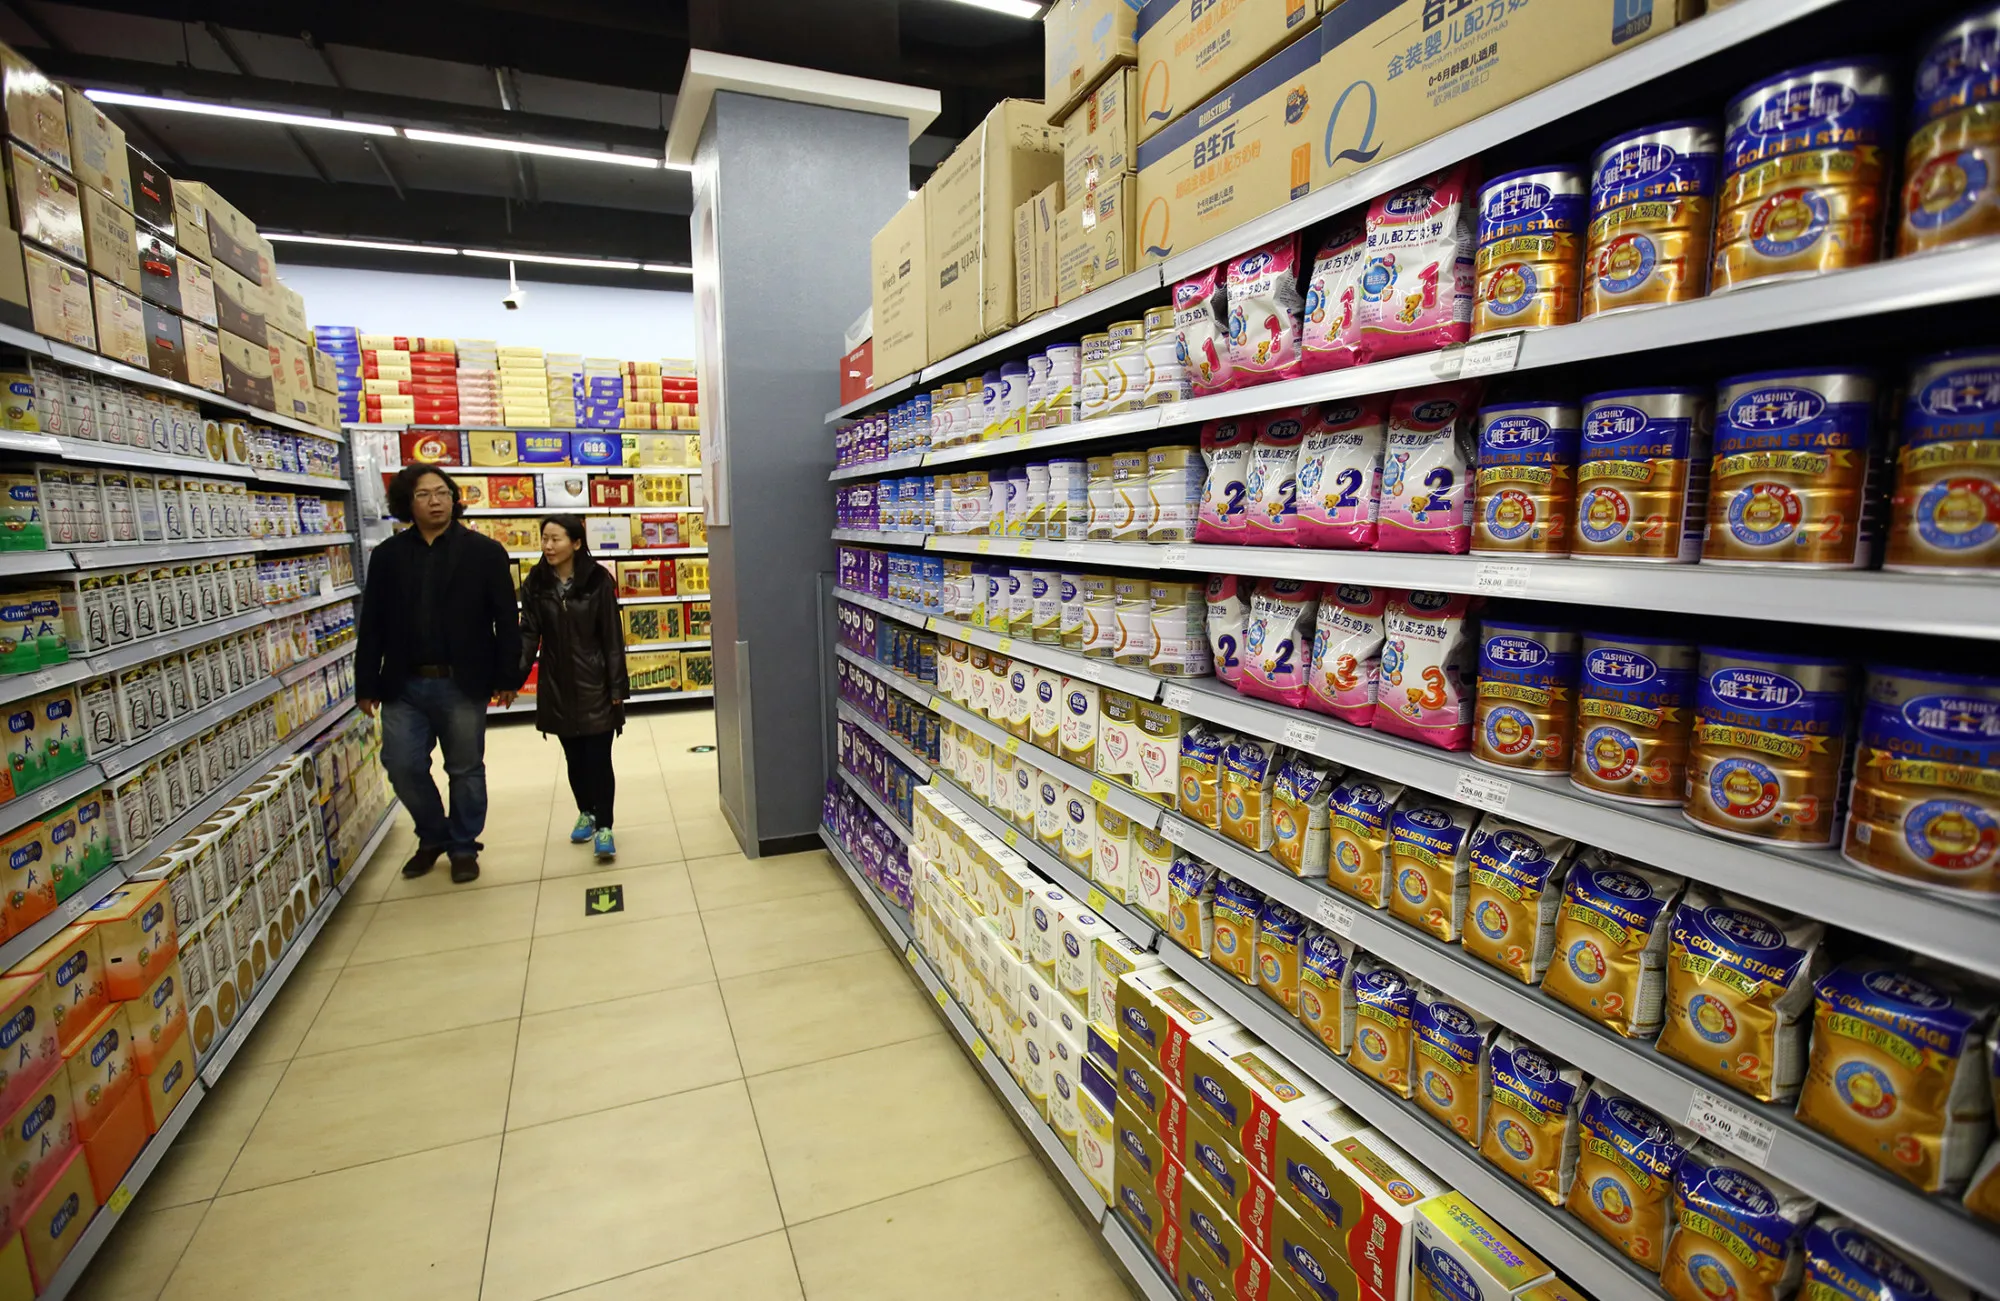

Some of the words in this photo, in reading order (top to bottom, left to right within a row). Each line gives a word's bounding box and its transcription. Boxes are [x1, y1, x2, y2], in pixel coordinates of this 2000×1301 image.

[1421, 51, 1453, 73] Premium
[1477, 20, 1508, 42] Formula
[1193, 123, 1236, 169] 合生元
[1603, 156, 1662, 185] 雅士利
[1418, 261, 1440, 310] 1
[1264, 314, 1283, 354] 1
[1752, 391, 1797, 404] YASHILY
[1500, 419, 1530, 428] YASHILY
[1595, 409, 1624, 419] YASHILY
[1737, 401, 1812, 424] 雅士利
[1491, 427, 1540, 444] 雅士利
[1587, 417, 1636, 438] 雅士利
[1618, 444, 1672, 457] STAGE
[1224, 480, 1246, 516] 2
[1336, 468, 1363, 508] 2
[1423, 466, 1455, 512] 2
[1644, 515, 1664, 539] 2
[1820, 514, 1842, 541] 2
[1218, 633, 1239, 667] 2
[1491, 647, 1539, 663] 雅士利
[1500, 639, 1530, 649] YASHILY
[1273, 639, 1295, 674] 2
[1601, 652, 1634, 663] YASHILY
[1335, 654, 1358, 692] 3
[1591, 659, 1645, 680] 雅士利
[1732, 672, 1776, 685] YASHILY
[1419, 665, 1448, 711] 3
[1628, 691, 1681, 705] STAGE
[1718, 680, 1788, 704] 雅士利
[1604, 701, 1659, 726] 幼儿配方奶粉
[1701, 706, 1762, 728] GOLDEN
[1766, 717, 1829, 733] STAGE
[1545, 734, 1562, 758] 3
[1736, 730, 1804, 758] 幼儿配方奶粉
[1650, 758, 1671, 783] 3
[1794, 795, 1818, 824] 3
[1426, 836, 1453, 853] STAGE
[1360, 878, 1375, 895] 2
[1512, 868, 1538, 886] STAGE
[1598, 876, 1646, 898] 雅士利
[1428, 909, 1444, 927] 2
[1611, 905, 1648, 928] STAGE
[1714, 915, 1774, 947] 雅士利
[1508, 947, 1524, 968] 2
[1674, 928, 1743, 966] α-GOLDEN
[1744, 958, 1785, 981] STAGE
[1603, 992, 1624, 1017] 2
[1323, 1027, 1334, 1042] 2
[1898, 1017, 1952, 1050] STAGE
[1449, 1042, 1474, 1060] STAGE
[1386, 1069, 1400, 1084] 2
[1736, 1054, 1761, 1082] 2
[1532, 1090, 1564, 1111] STAGE
[1455, 1116, 1470, 1134] 2
[1703, 1112, 1732, 1133] 69.00
[1636, 1150, 1671, 1177] STAGE
[1738, 1219, 1782, 1255] STAGE
[1494, 1240, 1526, 1267] STAGE
[1437, 1255, 1476, 1300] 雅士利
